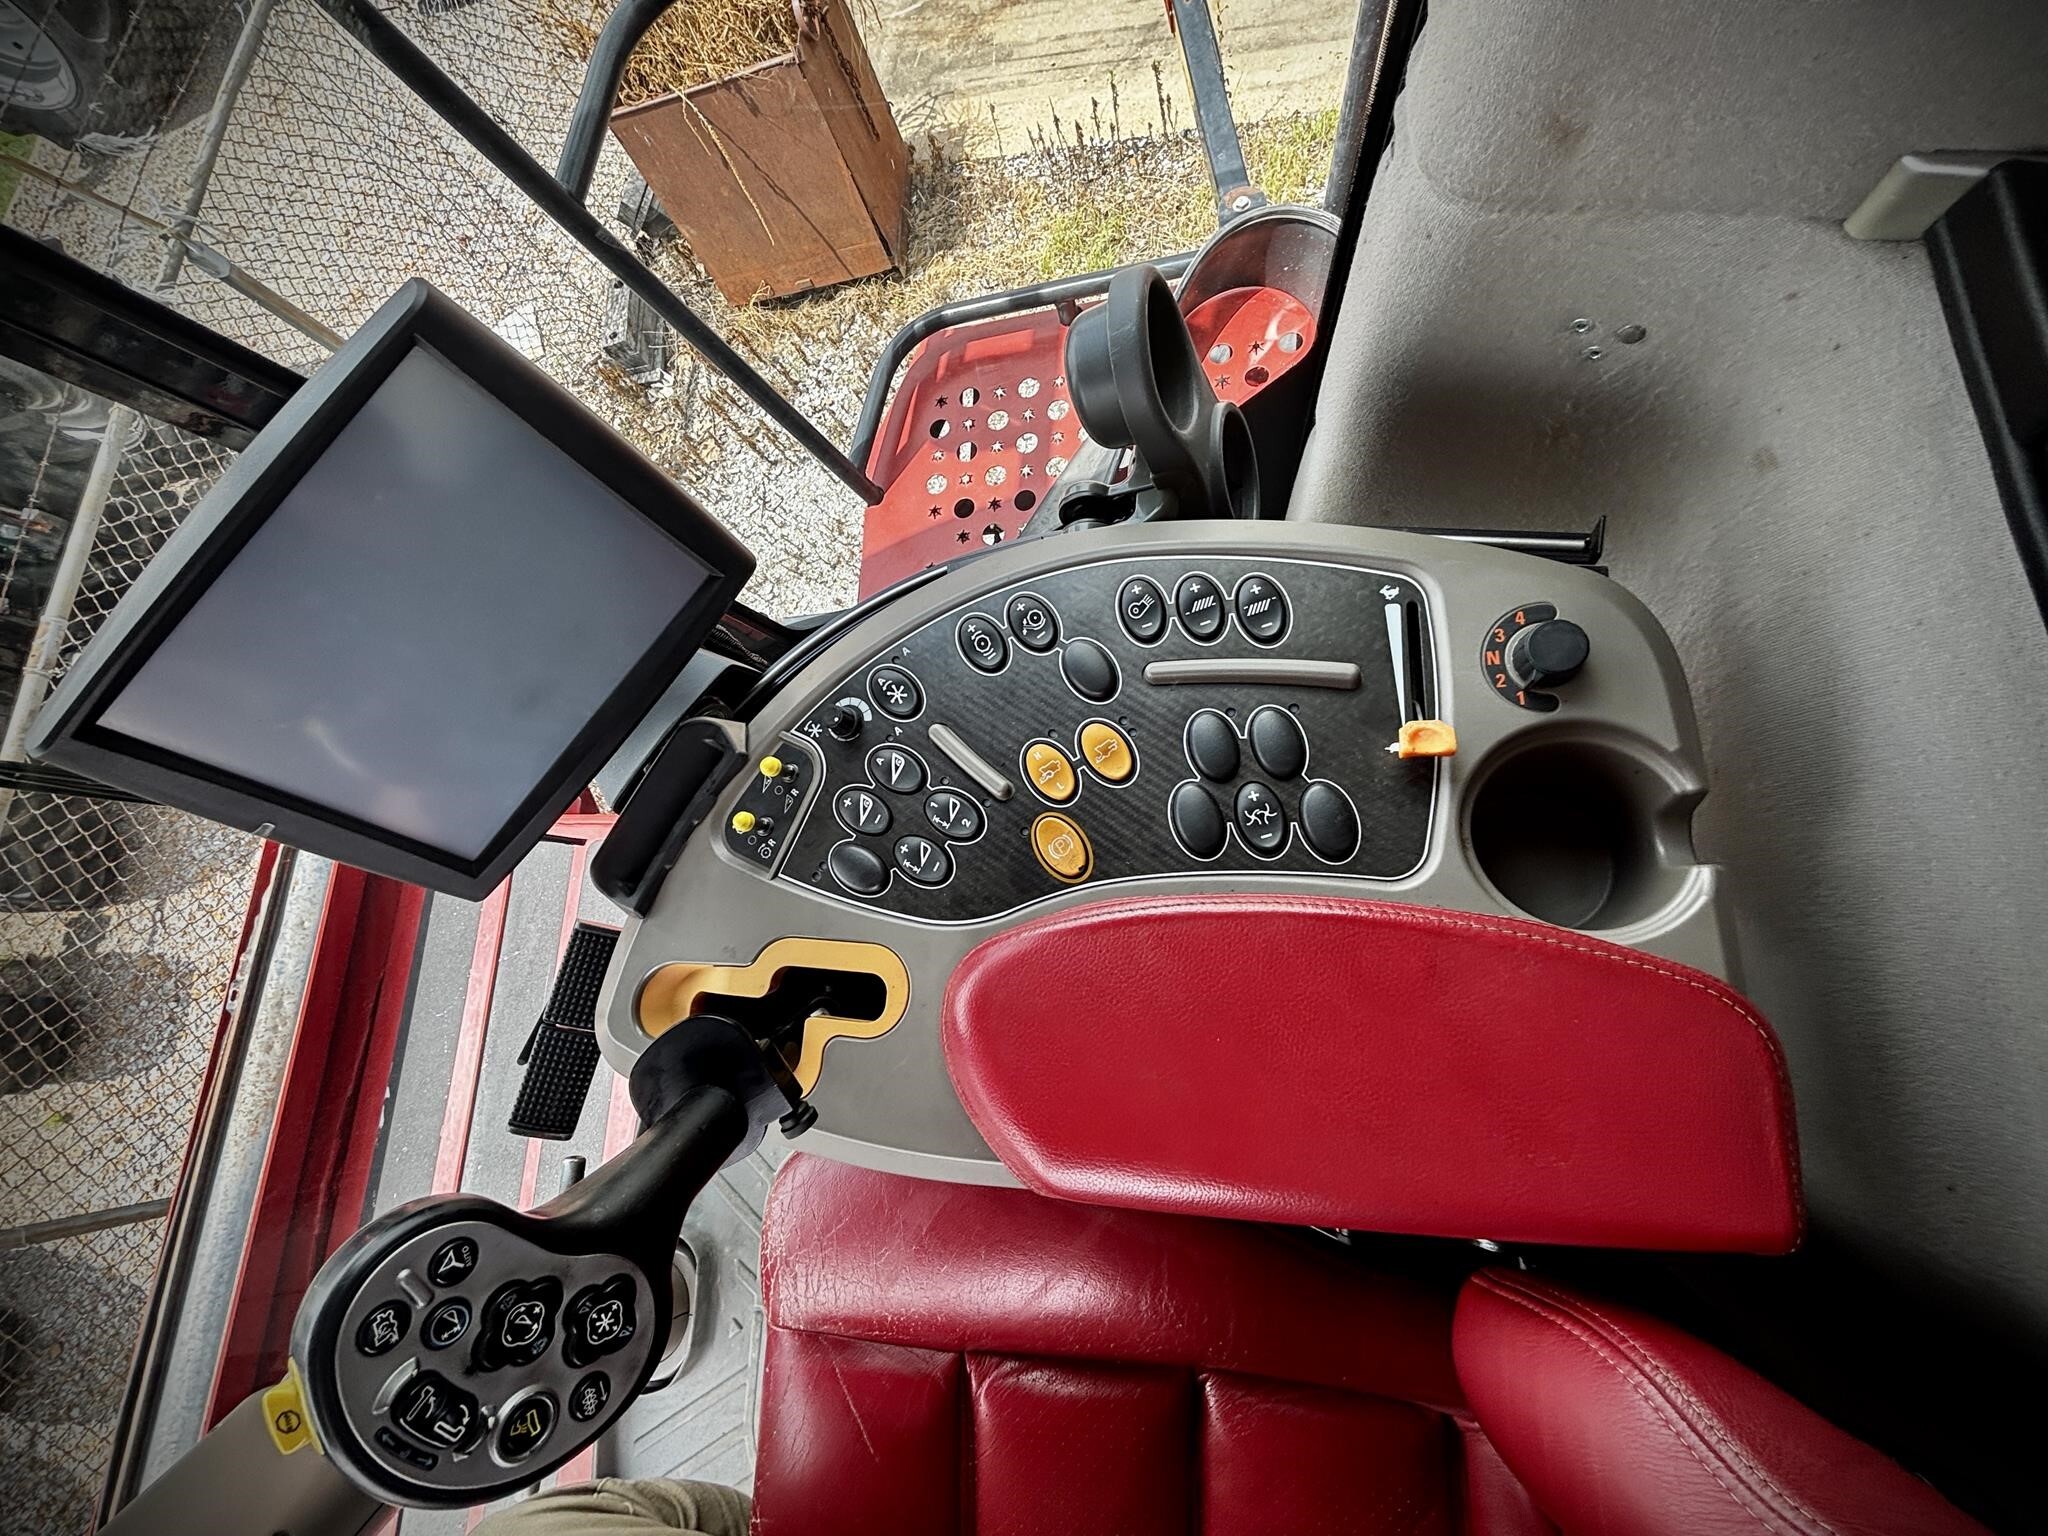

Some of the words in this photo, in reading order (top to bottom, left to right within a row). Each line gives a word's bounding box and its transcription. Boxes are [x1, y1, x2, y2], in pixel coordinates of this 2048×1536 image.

[1515, 611, 1526, 625] 4
[1494, 628, 1505, 642] 3
[902, 646, 911, 656] A
[1486, 650, 1500, 665] N
[1496, 673, 1507, 688] 2
[1516, 691, 1526, 705] 1
[894, 726, 903, 736] A
[876, 757, 885, 766] A
[790, 788, 800, 797] R
[961, 818, 971, 828] 2
[767, 838, 777, 847] R
